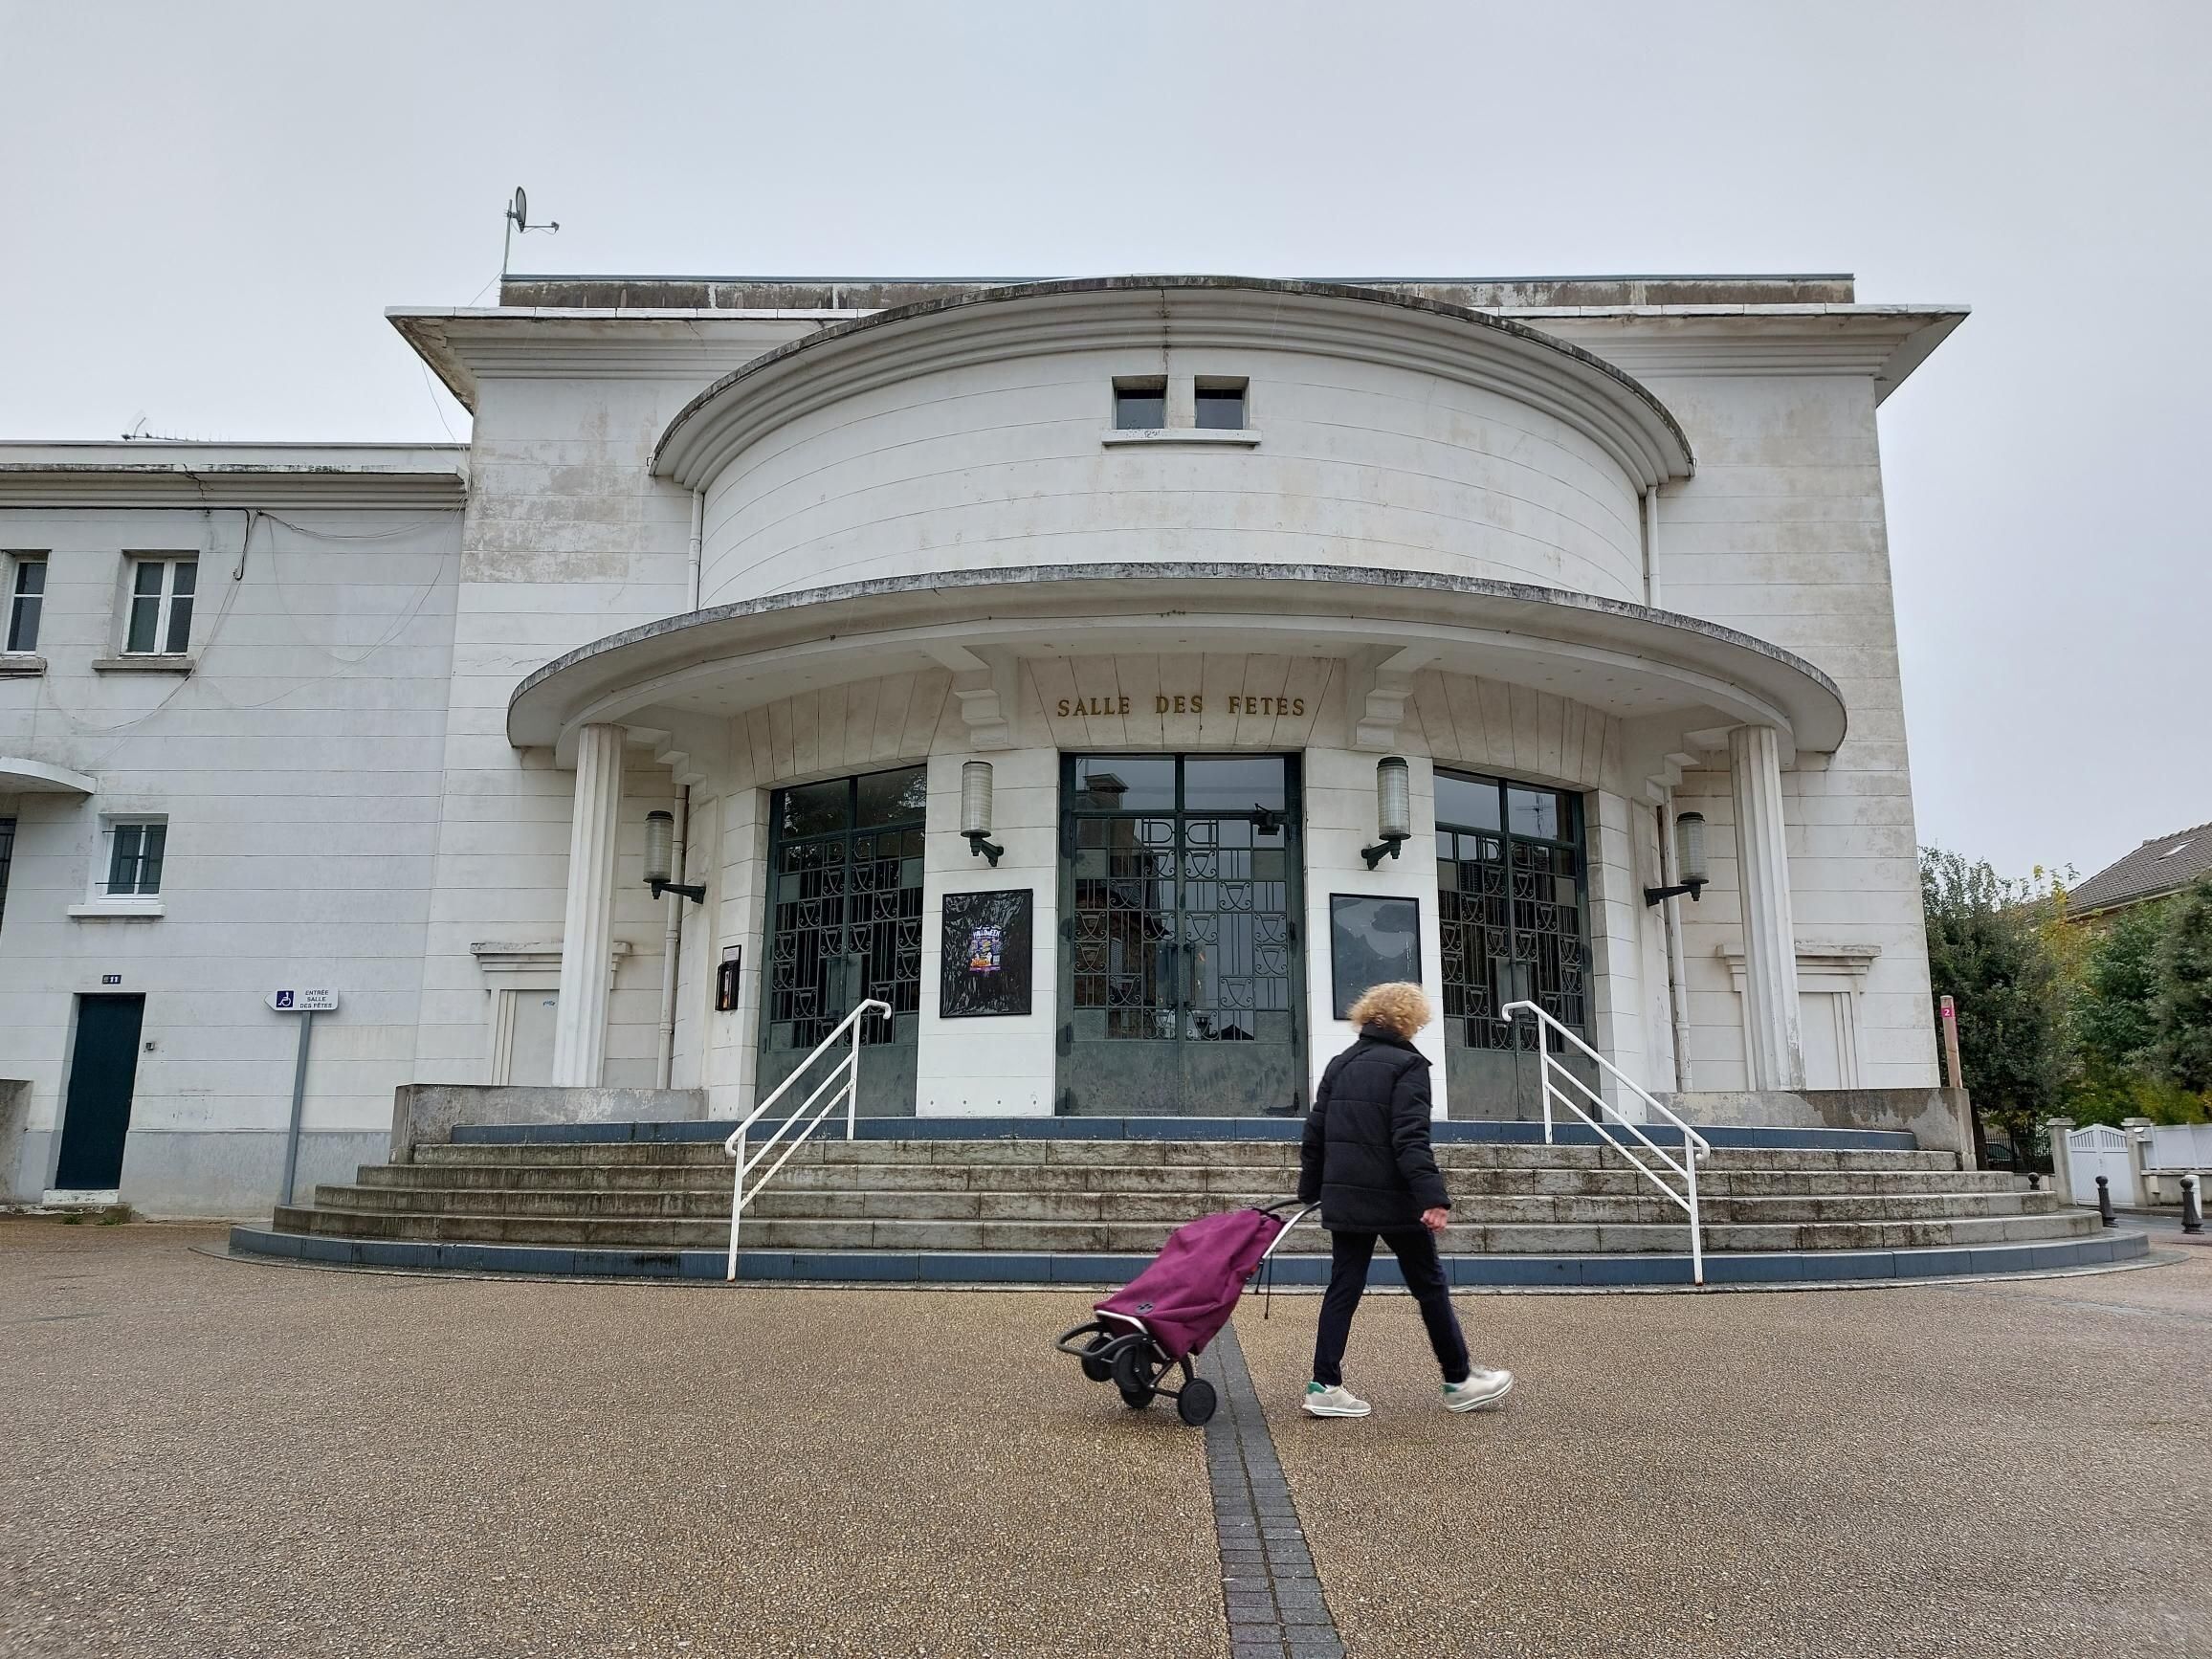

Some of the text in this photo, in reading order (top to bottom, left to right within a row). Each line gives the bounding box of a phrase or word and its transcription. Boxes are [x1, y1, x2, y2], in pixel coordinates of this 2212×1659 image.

[1057, 695, 1305, 718] SALLE DES FETES
